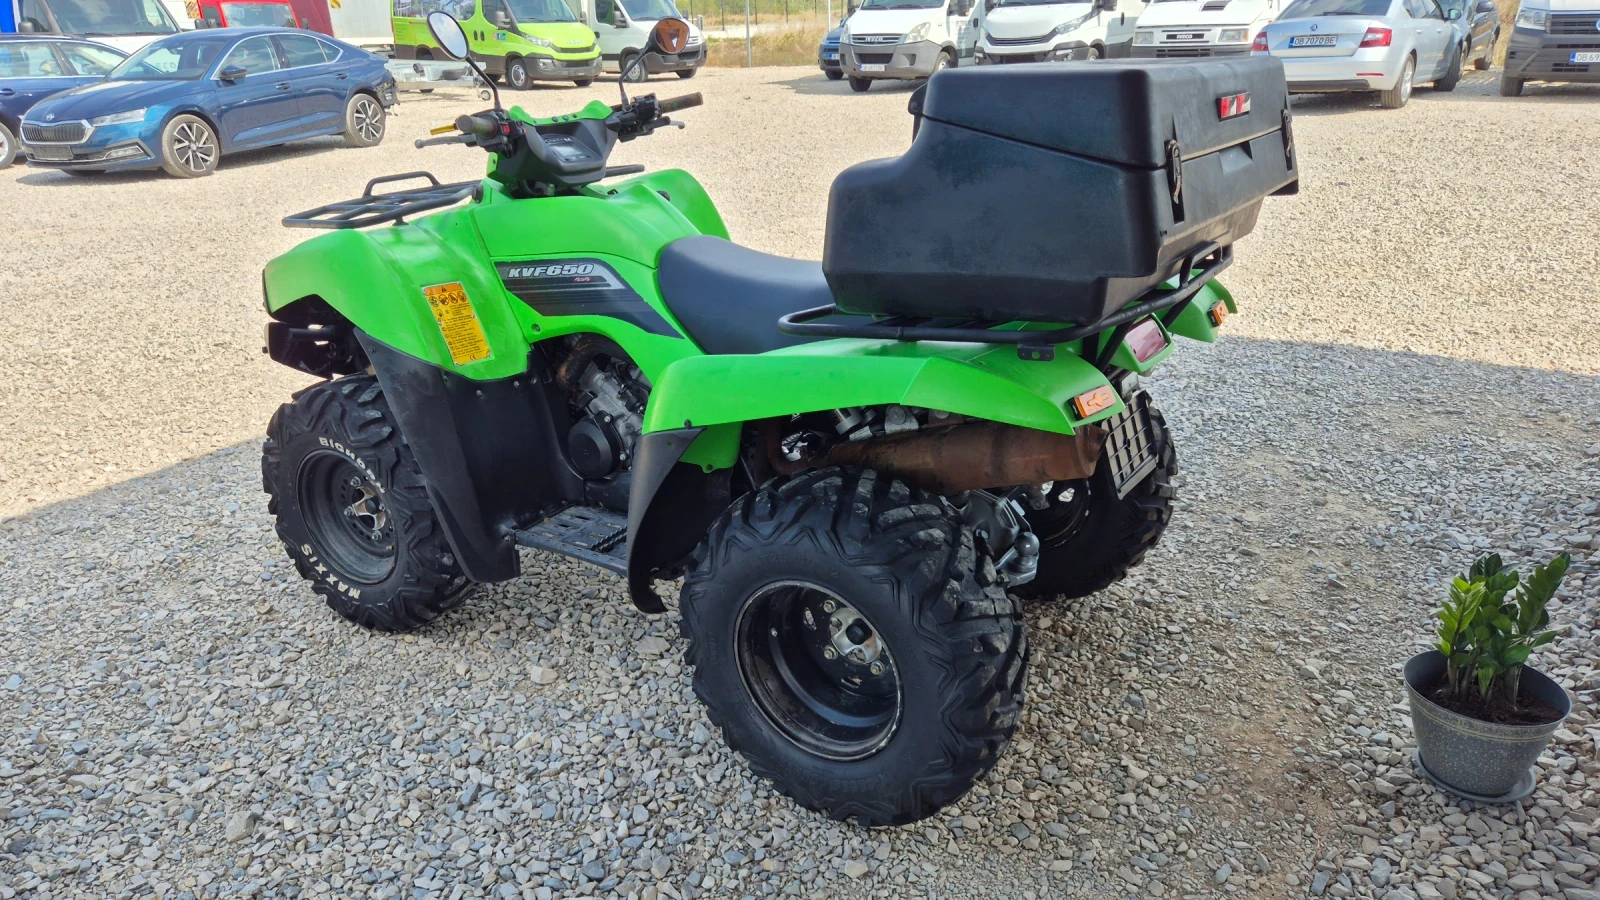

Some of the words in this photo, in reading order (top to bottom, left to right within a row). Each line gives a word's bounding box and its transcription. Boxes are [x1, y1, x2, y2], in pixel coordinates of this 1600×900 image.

[1294, 37, 1305, 46] OB
[1305, 37, 1324, 45] 7070
[1324, 36, 1336, 45] BE
[1577, 53, 1588, 61] OB
[508, 264, 595, 278] KVF650
[301, 543, 361, 599] MAXXIS
